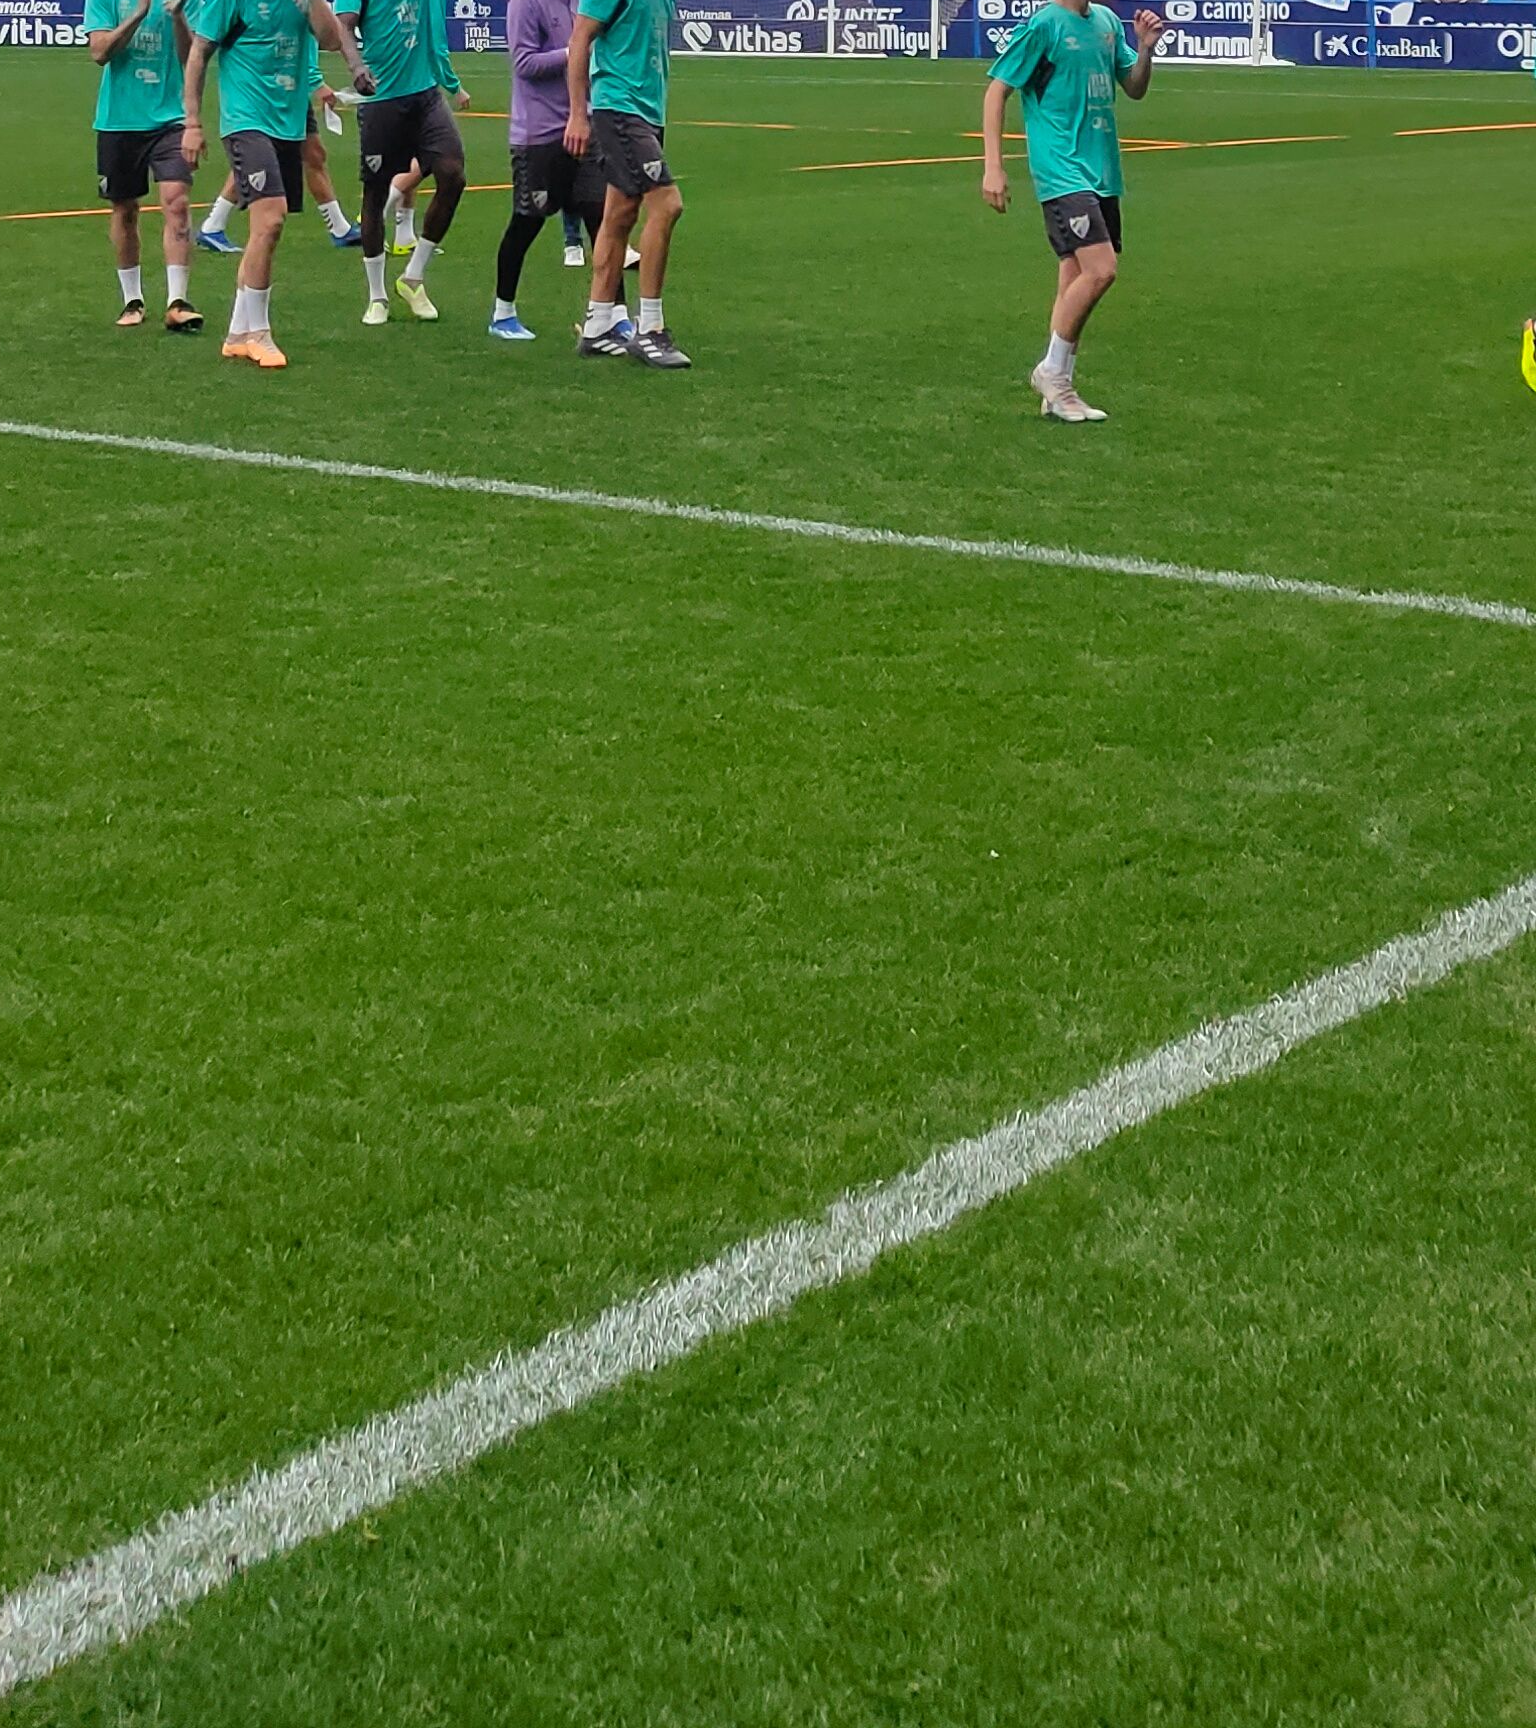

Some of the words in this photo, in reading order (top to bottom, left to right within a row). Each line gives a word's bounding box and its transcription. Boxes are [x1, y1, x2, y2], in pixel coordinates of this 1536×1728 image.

[718, 22, 803, 53] vithas
[837, 23, 948, 57] SanMigul
[1351, 35, 1443, 59] CixaBank
